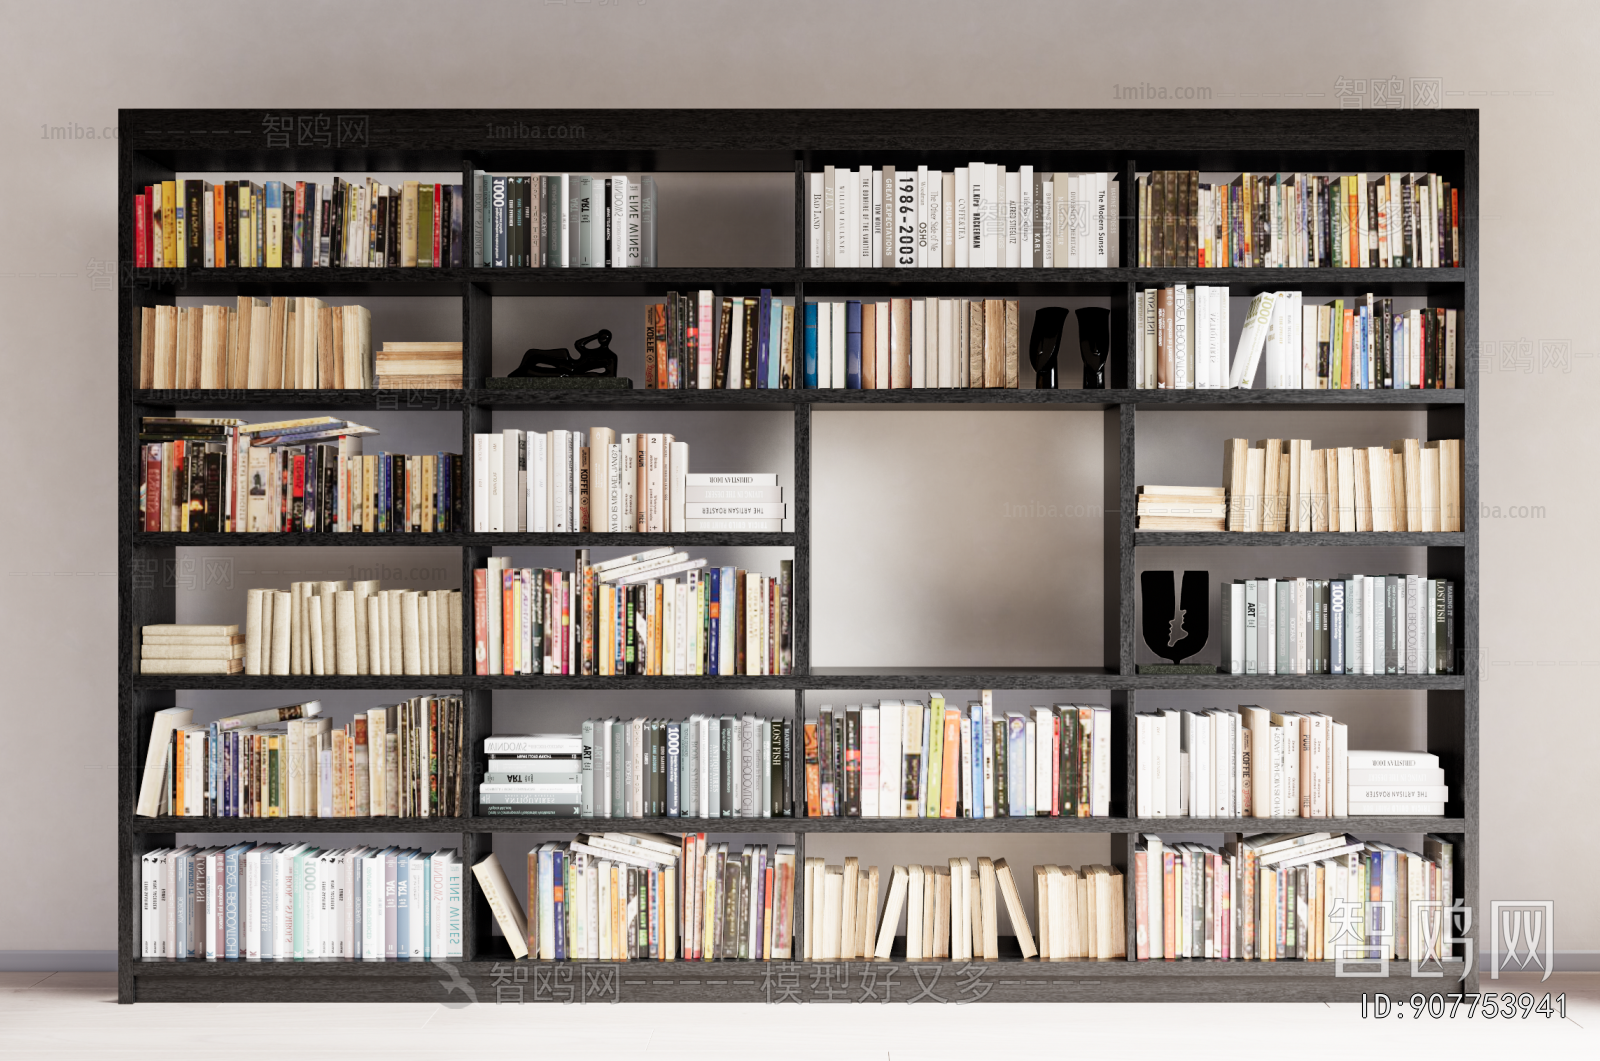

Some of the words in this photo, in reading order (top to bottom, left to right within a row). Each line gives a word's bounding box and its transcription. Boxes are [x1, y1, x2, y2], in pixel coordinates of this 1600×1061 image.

[862, 178, 870, 188] THE
[885, 178, 893, 202] GREAT
[813, 193, 822, 209] BAD
[862, 189, 870, 212] BONFIRE
[929, 191, 939, 201] The
[1098, 190, 1106, 204] The
[813, 210, 822, 230] LAND
[929, 203, 939, 220] Other
[1098, 204, 1106, 231] Modern
[862, 222, 870, 232] THE
[885, 203, 893, 256] EXPECTATIONS
[899, 177, 914, 265] 1986-2003
[929, 221, 939, 234] Side
[918, 221, 927, 248] OSHO
[929, 234, 939, 242] of
[1098, 232, 1106, 255] Sunset
[862, 233, 870, 257] VANITIES
[929, 242, 939, 252] Me
[611, 449, 619, 473] JANG?
[638, 450, 646, 468] PUUR
[580, 468, 589, 496] KOFFIE
[709, 476, 724, 484] DIOR
[724, 476, 754, 484] CHRISTIAN
[611, 473, 619, 506] MICHAEL
[705, 490, 725, 499] DESERT
[726, 490, 737, 499] THE
[737, 490, 742, 499] IN
[743, 490, 764, 499] LIVING
[611, 513, 619, 533] WHO
[638, 510, 646, 525] THEE
[1332, 584, 1344, 613] 1000
[1407, 577, 1416, 611] ALEXEY
[1436, 580, 1446, 603] LOST
[1247, 602, 1256, 618] ART
[1436, 604, 1446, 623] FISH
[1407, 612, 1416, 667] BRODOVITCH
[668, 727, 680, 755] 1000
[742, 720, 753, 754] ALEXEY
[772, 724, 781, 745] LOST
[1273, 732, 1281, 755] JANG?
[1303, 734, 1311, 752] PUUR
[583, 745, 592, 760] ART
[594, 745, 603, 760] ART
[691, 741, 699, 761] BOOK
[772, 746, 781, 766] FISH
[1242, 751, 1251, 778] KOFFIE
[1273, 756, 1281, 788] MICHAEL
[1371, 759, 1386, 767] DIOR
[1387, 759, 1416, 767] CHRISTIAN
[691, 767, 699, 803] SYMBOLS
[742, 755, 753, 811] BRODOVITCH
[1368, 773, 1388, 782] DESERT
[1388, 773, 1400, 782] THE
[1401, 773, 1407, 782] IN
[1407, 773, 1427, 782] LIVING
[1273, 788, 1281, 796] IS
[1303, 794, 1311, 808] THEE
[1273, 796, 1281, 817] WHO
